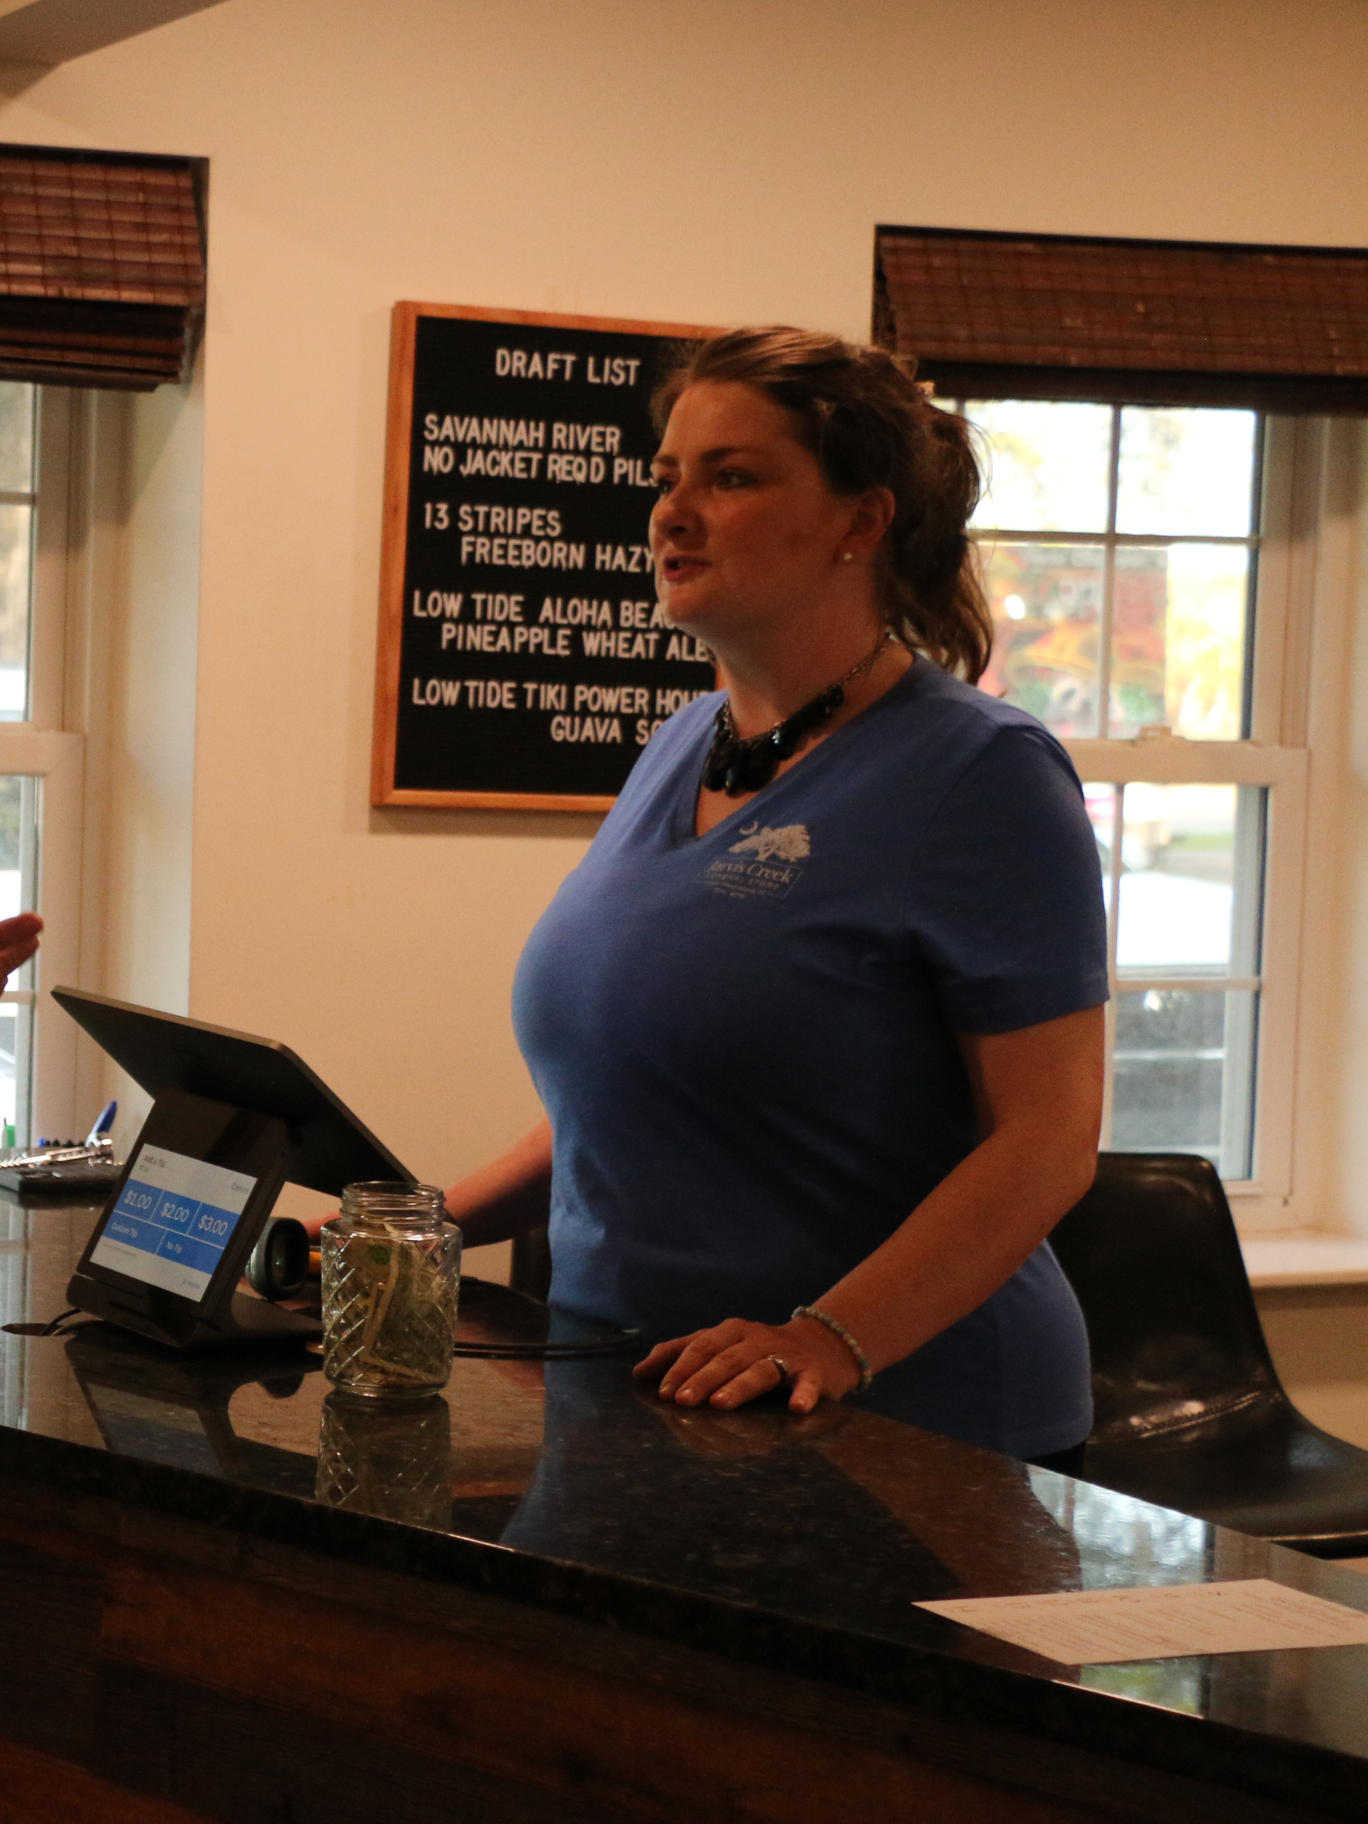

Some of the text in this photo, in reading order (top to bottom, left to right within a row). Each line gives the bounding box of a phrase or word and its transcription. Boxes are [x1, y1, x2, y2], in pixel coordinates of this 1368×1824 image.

[495, 348, 640, 386] DRAFT LIST
[423, 412, 621, 455] SAVANNAH RIVER
[423, 445, 454, 475] NO
[459, 448, 543, 478] JACKET
[613, 457, 658, 487] PIL
[424, 502, 562, 538] 13 STRIPES
[461, 535, 584, 572] FREEBORN
[413, 589, 463, 619] LOW
[471, 593, 524, 622] TIDE
[538, 597, 613, 629] ALOHA
[441, 622, 572, 657] PINEAPPLE
[582, 631, 660, 660] WHEAT
[412, 678, 461, 706] LOW
[464, 680, 517, 710] TIDE
[523, 682, 567, 711] TIKI
[573, 685, 650, 716] POWER
[550, 715, 623, 743] GUAVA
[124, 1190, 152, 1210] $1.00
[161, 1202, 190, 1223] $2.00
[198, 1215, 229, 1236] $3.00
